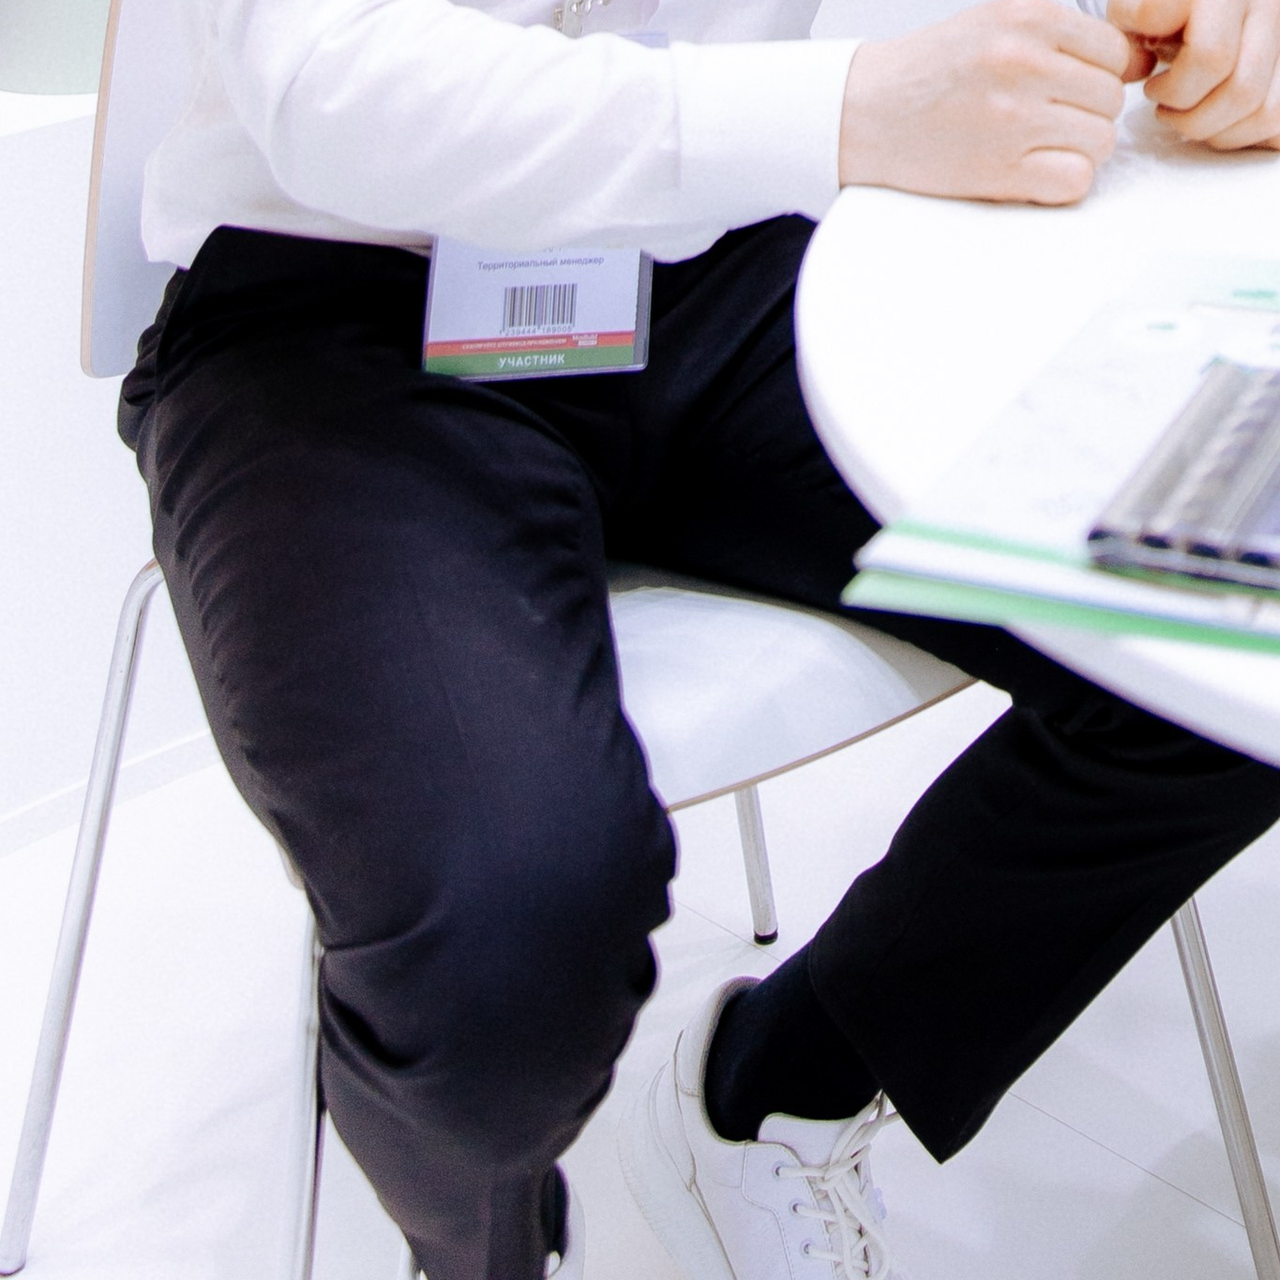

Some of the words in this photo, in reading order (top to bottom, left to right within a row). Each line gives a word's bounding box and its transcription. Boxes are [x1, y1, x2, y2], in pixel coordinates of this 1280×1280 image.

[477, 258, 558, 272] Территориальный
[560, 256, 605, 266] менеджер
[499, 354, 565, 368] УЧАСТНИК
